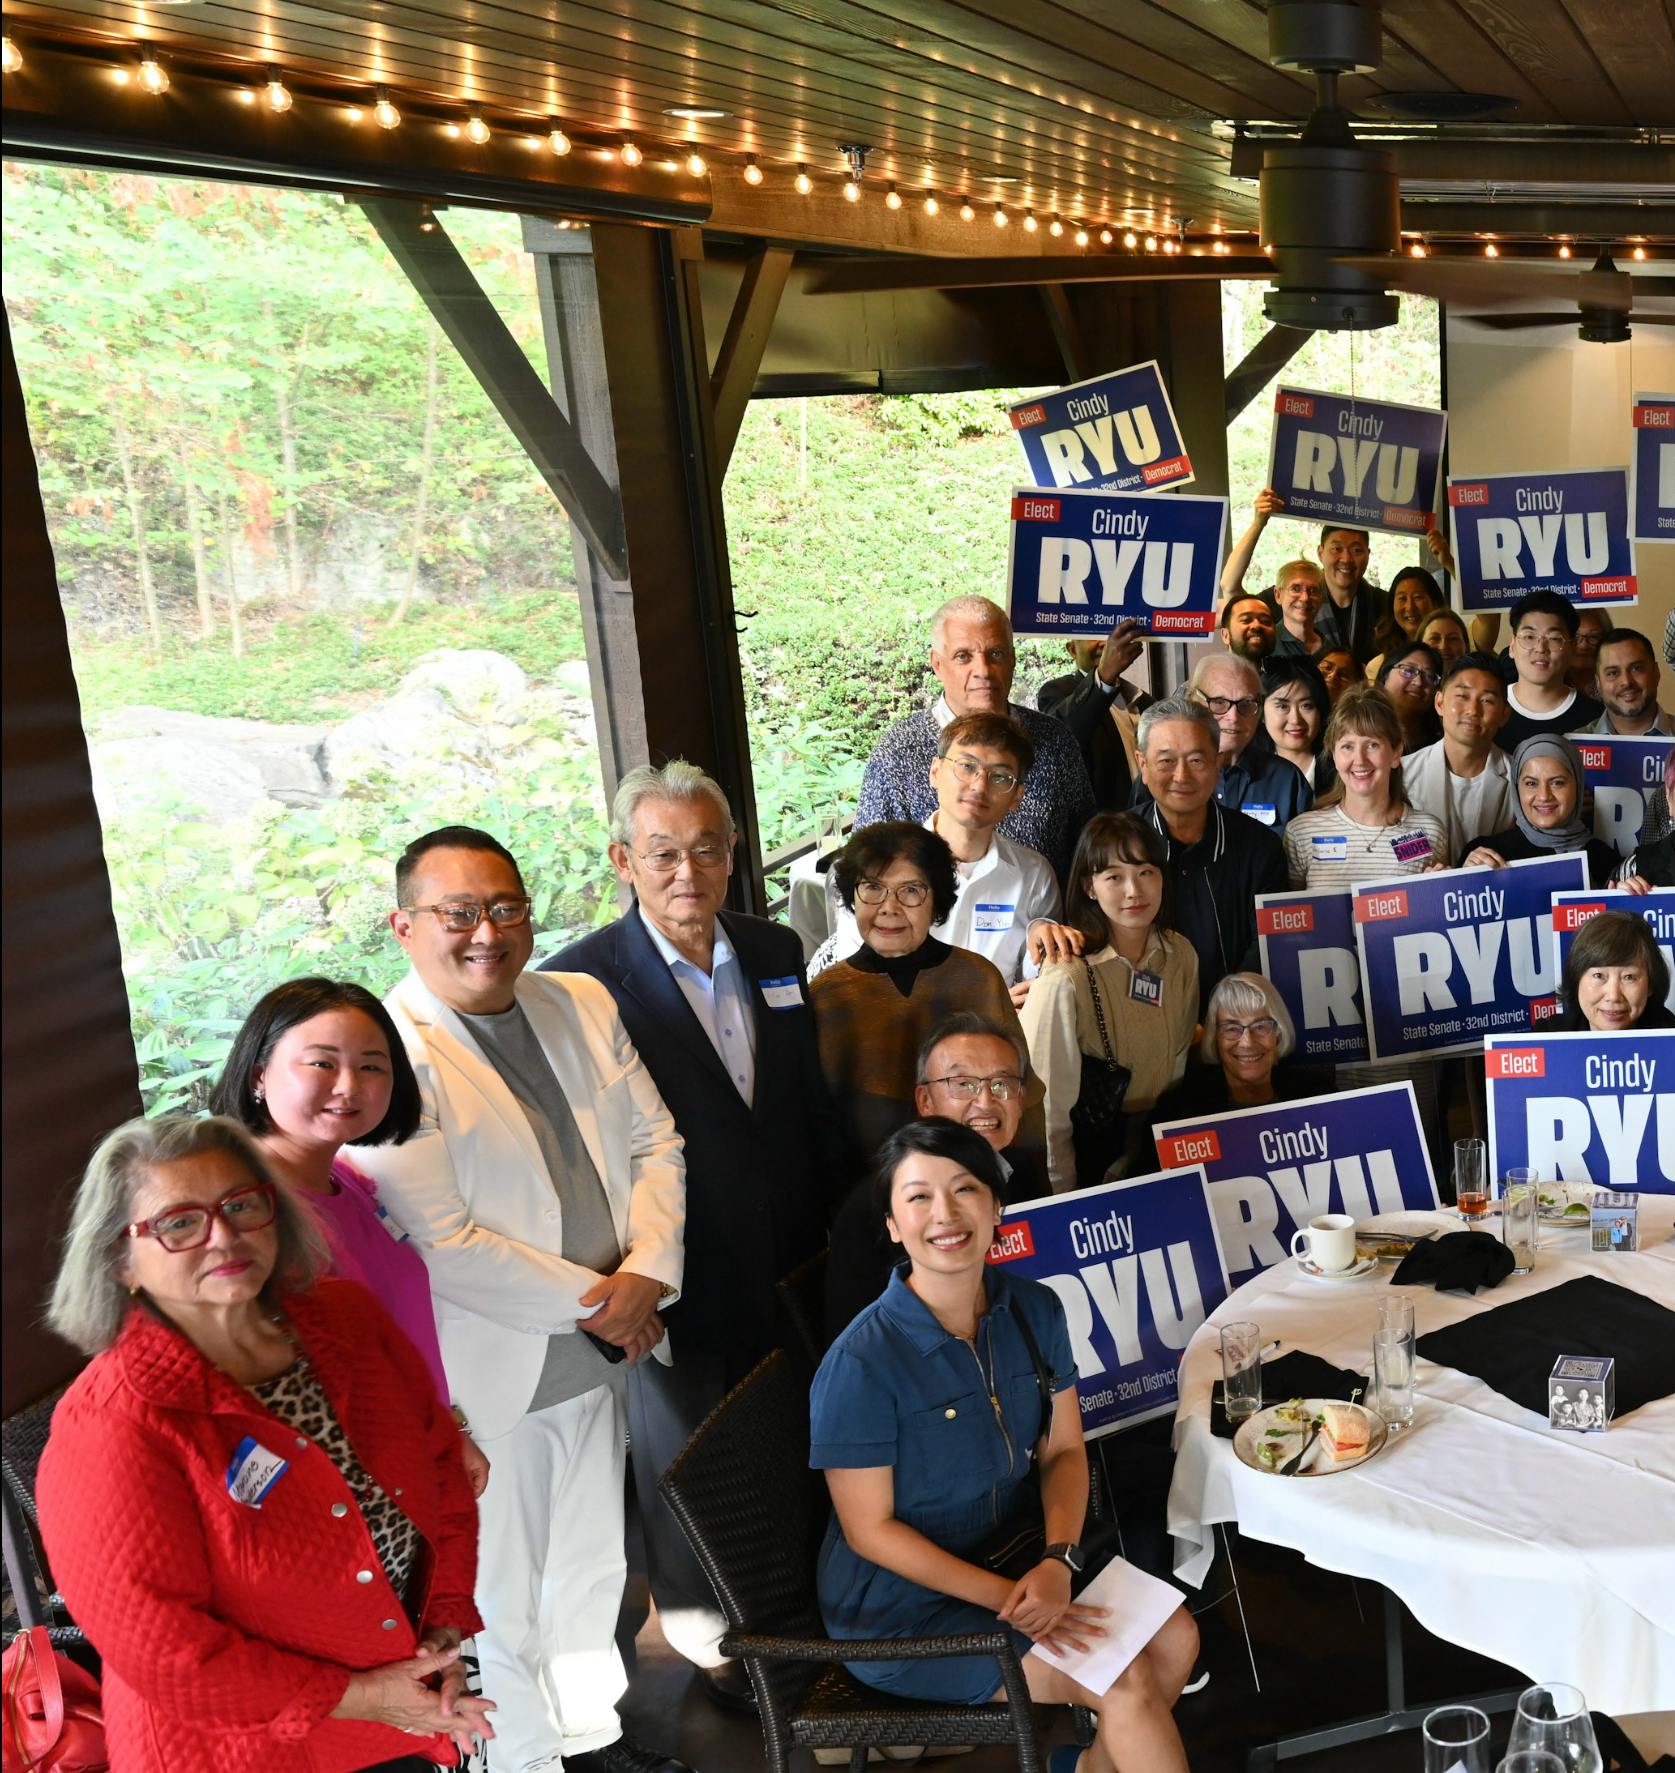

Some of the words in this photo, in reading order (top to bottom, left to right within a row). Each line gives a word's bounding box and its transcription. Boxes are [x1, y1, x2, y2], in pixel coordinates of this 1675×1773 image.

[1019, 408, 1041, 426] Elect
[1066, 392, 1110, 422] Cindy
[1285, 398, 1310, 415] Elect
[1644, 410, 1670, 425] Elect
[1338, 410, 1384, 441] Cindy
[1040, 404, 1161, 489] RYU
[1117, 475, 1141, 488] District
[1145, 461, 1183, 481] Democrat
[1292, 430, 1419, 505] RYU
[1458, 489, 1484, 503] Elect
[1515, 485, 1564, 513] Cindy
[1024, 502, 1055, 519] Elect
[1092, 509, 1149, 540] Cindy
[1290, 496, 1308, 508] State
[1308, 498, 1333, 512] Senate
[1335, 503, 1354, 515] 32nd
[1385, 508, 1426, 527] Democrat
[1477, 512, 1610, 581] RYU
[1037, 536, 1194, 608] RYU
[1483, 588, 1501, 599] State
[1502, 586, 1527, 598] Senate
[1550, 583, 1577, 594] District
[1584, 580, 1627, 594] Democrat
[1036, 612, 1058, 623] State
[1059, 613, 1089, 625] Senate
[1093, 614, 1115, 625] 32nd
[1155, 615, 1204, 628] Democrat
[1580, 749, 1606, 767] lect
[1368, 896, 1402, 918] Elect
[1443, 885, 1505, 922] Cindy
[1272, 910, 1308, 930] Elect
[1393, 913, 1556, 1016] RYU
[1135, 978, 1157, 998] RYU
[1403, 1025, 1427, 1040] State
[1429, 1020, 1460, 1036] Senate
[1465, 1017, 1489, 1030] 32nd
[1491, 1009, 1525, 1026] District
[1306, 1040, 1332, 1054] State
[1501, 1053, 1538, 1074] Elect
[1585, 1053, 1656, 1092] Cindy
[1174, 1137, 1214, 1162] Elect
[1259, 1122, 1328, 1164] Cindy
[1069, 1210, 1132, 1259] Cindy
[1080, 1391, 1114, 1413] Senate
[1117, 1380, 1142, 1401] 32nd
[1143, 1369, 1178, 1393] District
